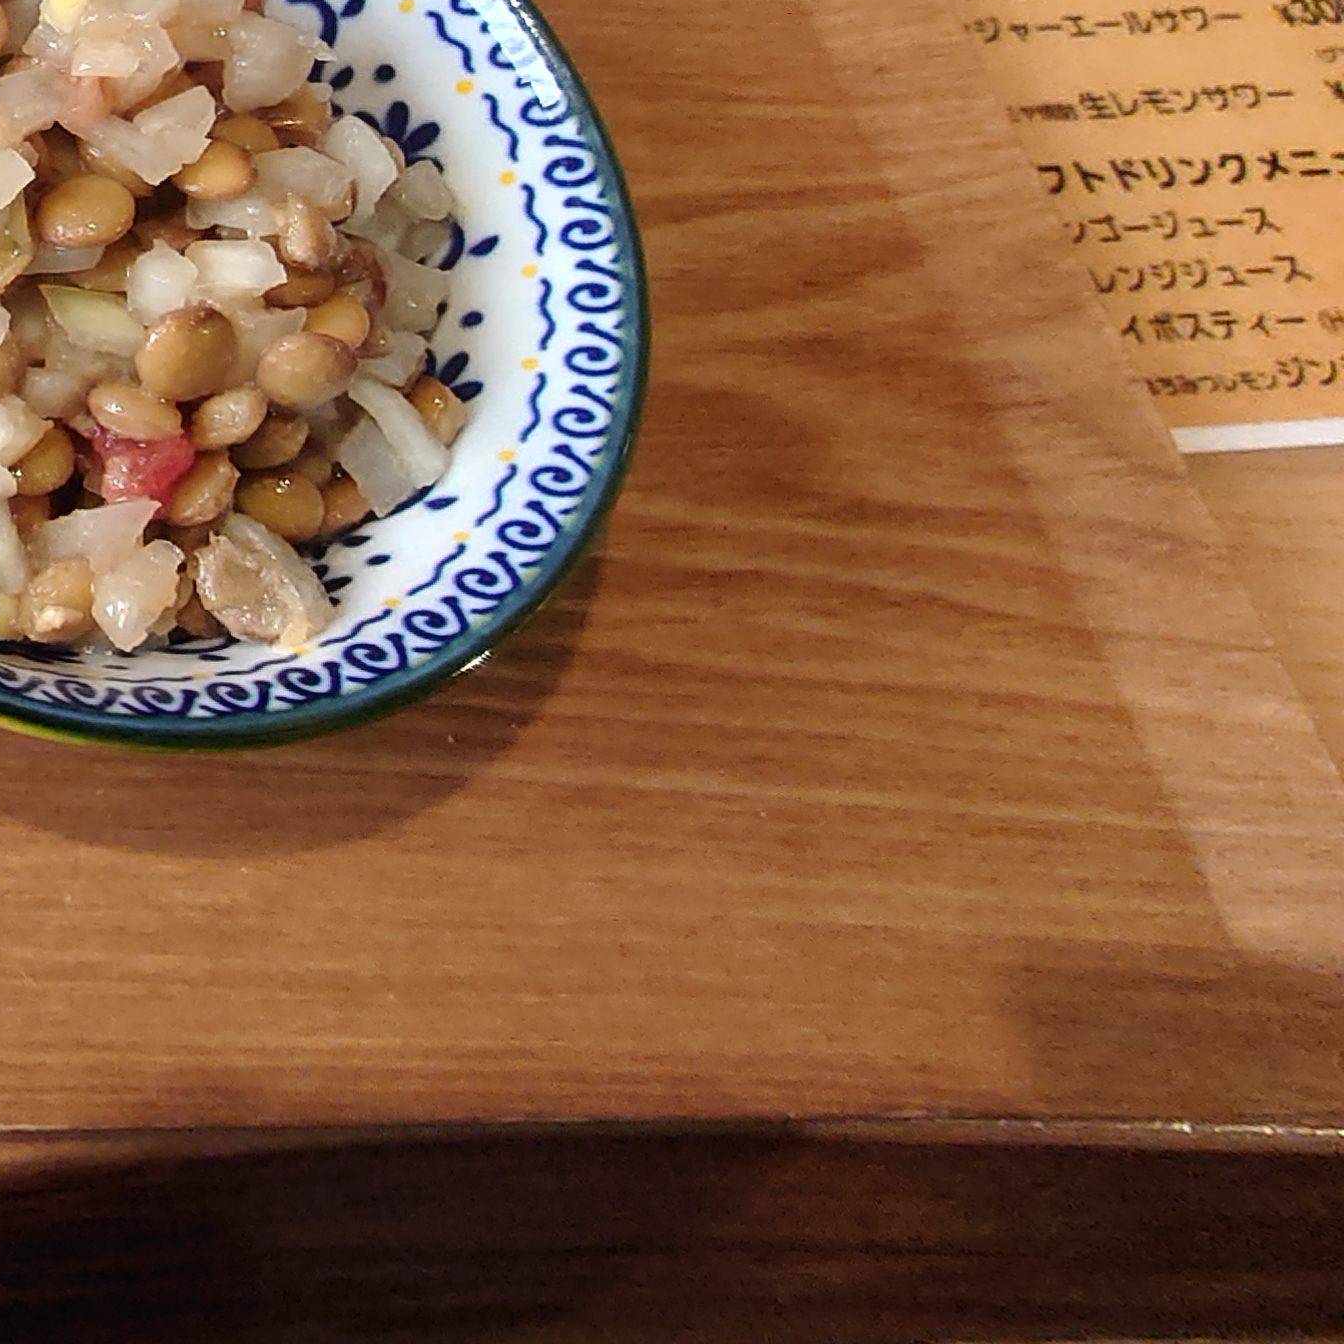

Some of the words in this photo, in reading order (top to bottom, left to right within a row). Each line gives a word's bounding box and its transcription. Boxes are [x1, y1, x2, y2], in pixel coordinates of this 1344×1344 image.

[963, 5, 1243, 44] ジャーエールサワー
